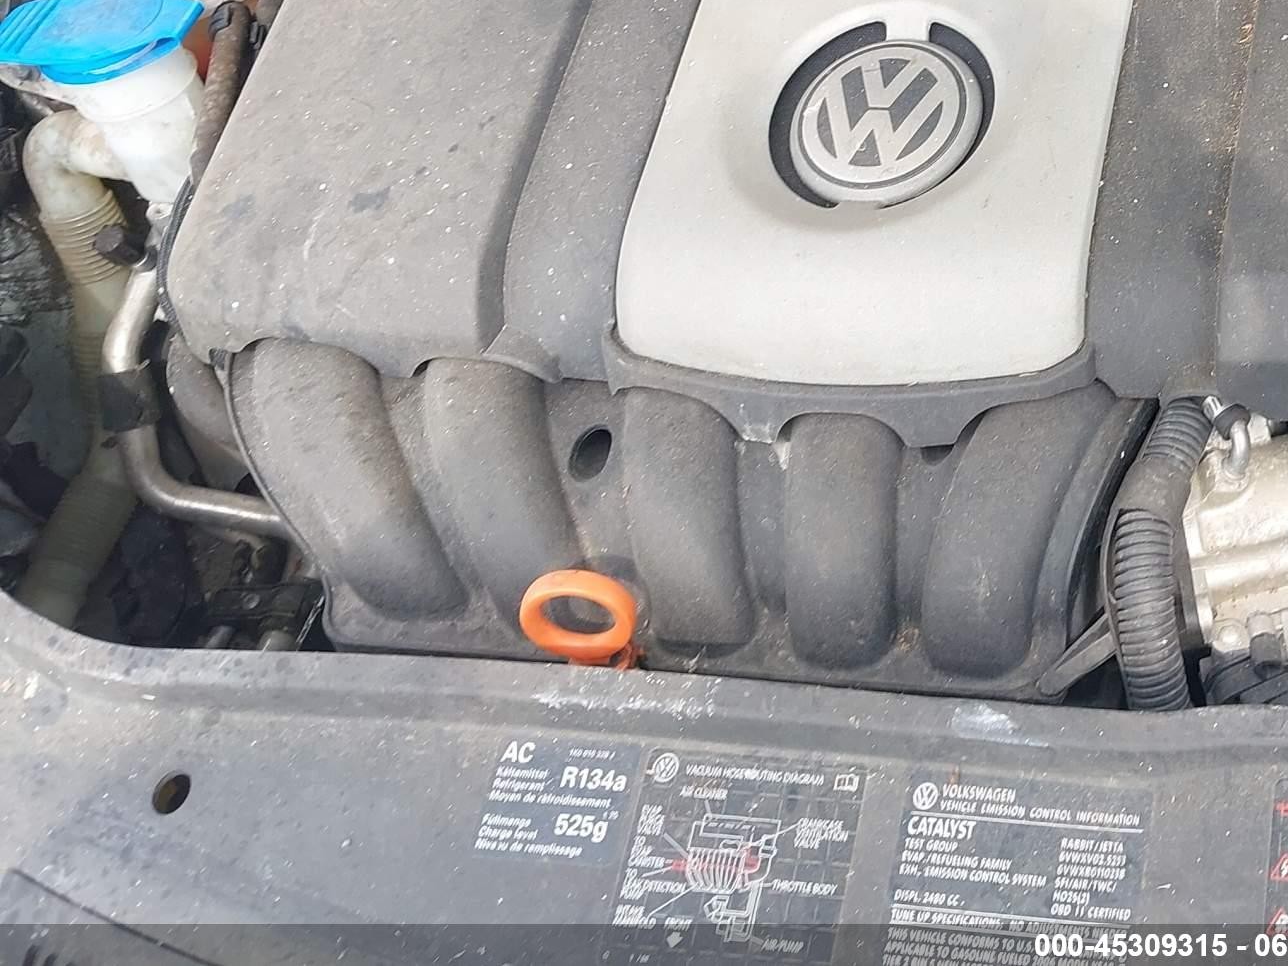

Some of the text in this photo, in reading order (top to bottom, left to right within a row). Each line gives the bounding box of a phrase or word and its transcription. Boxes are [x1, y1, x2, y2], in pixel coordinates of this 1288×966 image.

[500, 741, 536, 763] AC
[560, 766, 627, 791] R134a
[522, 792, 536, 803] de
[942, 784, 1016, 803] VOLKSWAGEN
[940, 799, 1140, 827] VEHICLE EMISSION CONTROL INFORMATION
[554, 814, 609, 844] 525g
[907, 816, 977, 840] CATALYST
[904, 837, 959, 853] TEST GROUP
[980, 858, 1013, 871] FAMILY
[924, 865, 968, 881] EMISSION
[969, 870, 1010, 885] CONTROL
[1011, 874, 1047, 888] SYSTEM
[890, 909, 915, 923] TUNE
[916, 912, 930, 923] UP
[1009, 920, 1025, 932] NO
[1050, 903, 1072, 916] OBD
[1087, 907, 1131, 921] CERTIFIED
[887, 927, 908, 942] THIS
[909, 930, 947, 945] VEHICLE
[948, 933, 1000, 950] CONFORMS
[1002, 938, 1015, 951] TO
[883, 941, 936, 957] APPLICABLE
[936, 945, 950, 959] TO
[950, 947, 996, 963] GASOLINE
